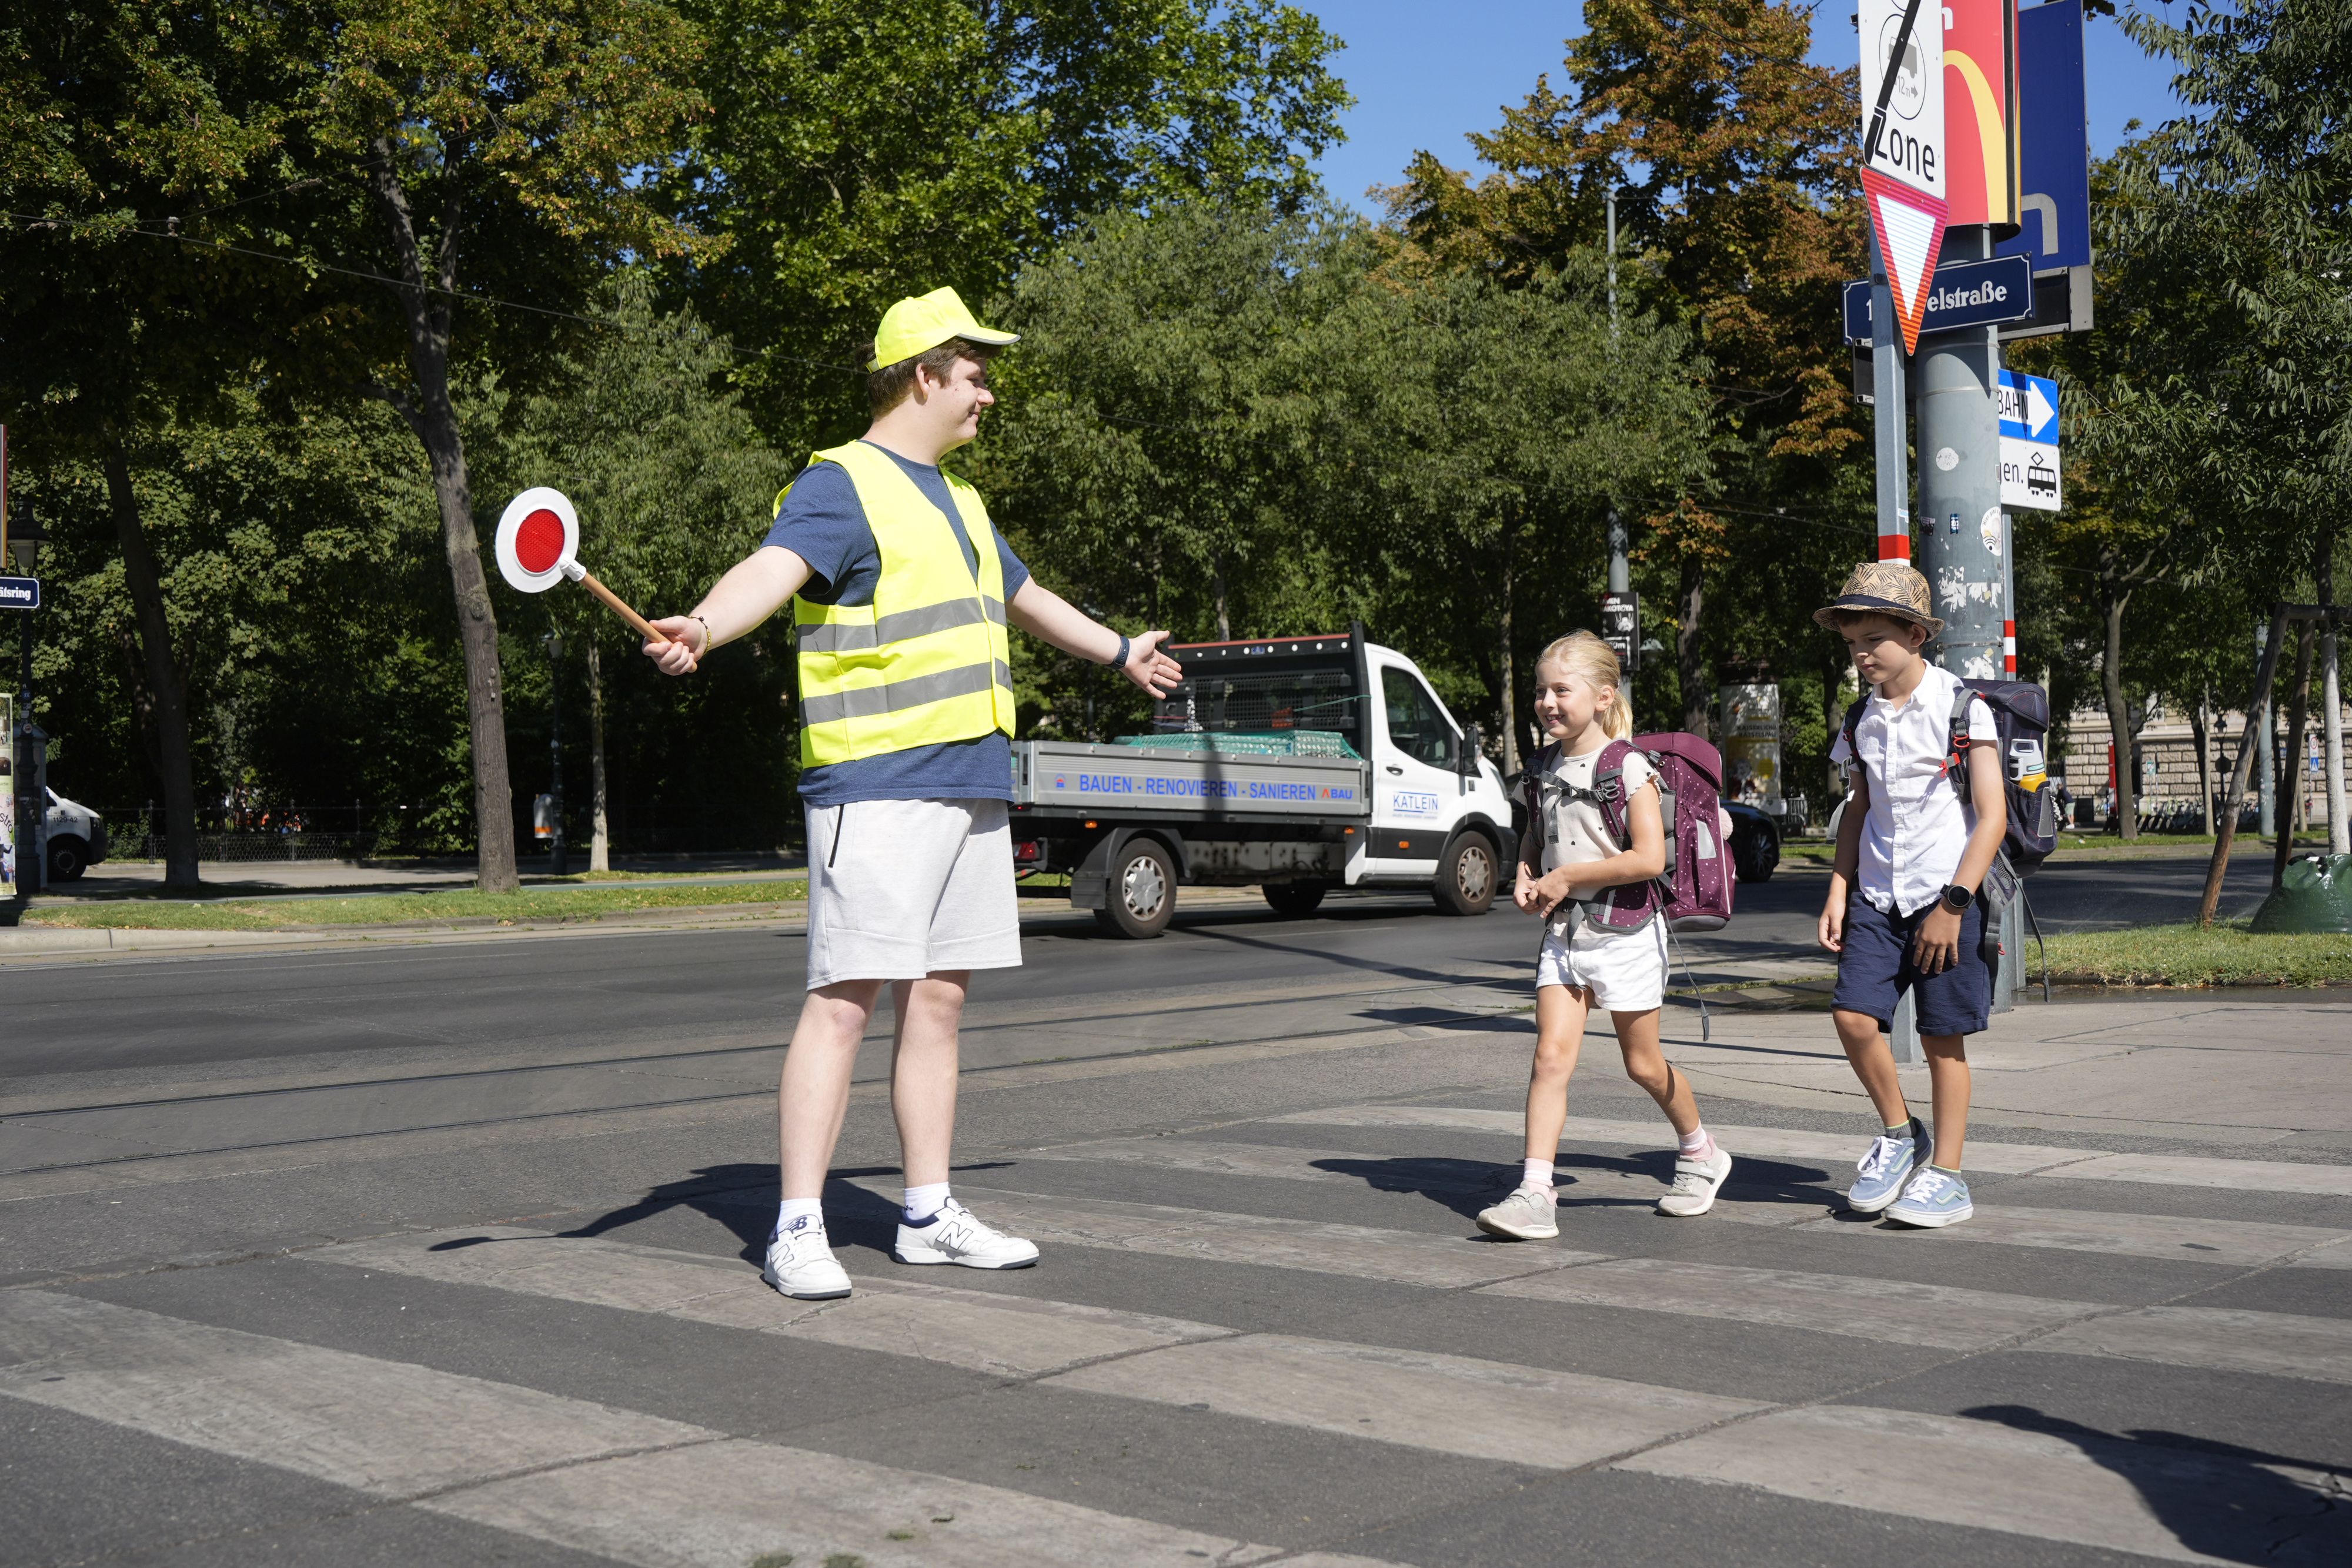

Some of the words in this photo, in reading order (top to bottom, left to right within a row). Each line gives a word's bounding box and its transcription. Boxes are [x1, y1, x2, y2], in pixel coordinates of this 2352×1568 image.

[1874, 106, 1935, 182] Zone
[1927, 280, 2007, 312] elstraße
[1999, 390, 2029, 420] BAHN
[2000, 462, 2023, 486] en.
[1080, 774, 1132, 793] BAUEN
[1146, 777, 1237, 797] RENOVIEREN
[1250, 783, 1316, 800] SANIEREN
[1393, 795, 1438, 810] KATLEIN
